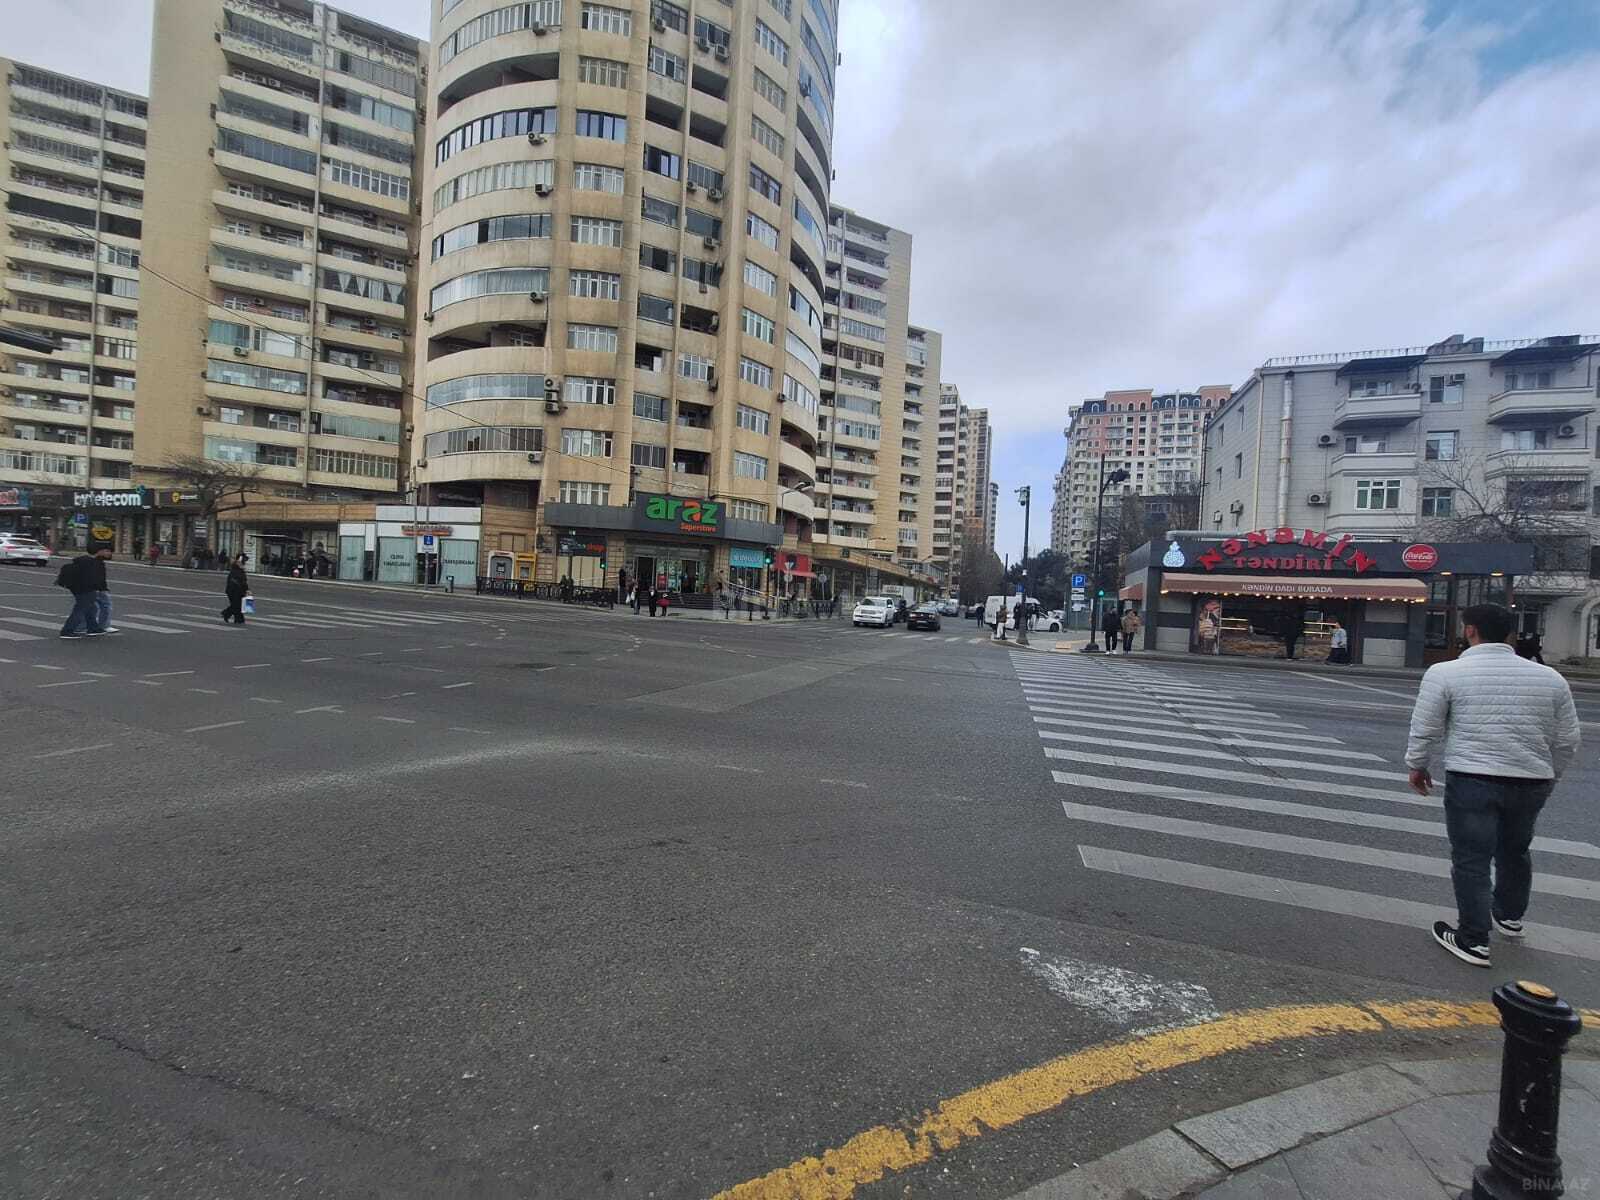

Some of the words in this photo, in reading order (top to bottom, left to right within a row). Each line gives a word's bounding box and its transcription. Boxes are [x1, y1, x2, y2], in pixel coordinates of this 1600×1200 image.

[646, 496, 719, 525] araz
[1233, 554, 1334, 571] TƏNDİRİ
[1075, 576, 1083, 586] P
